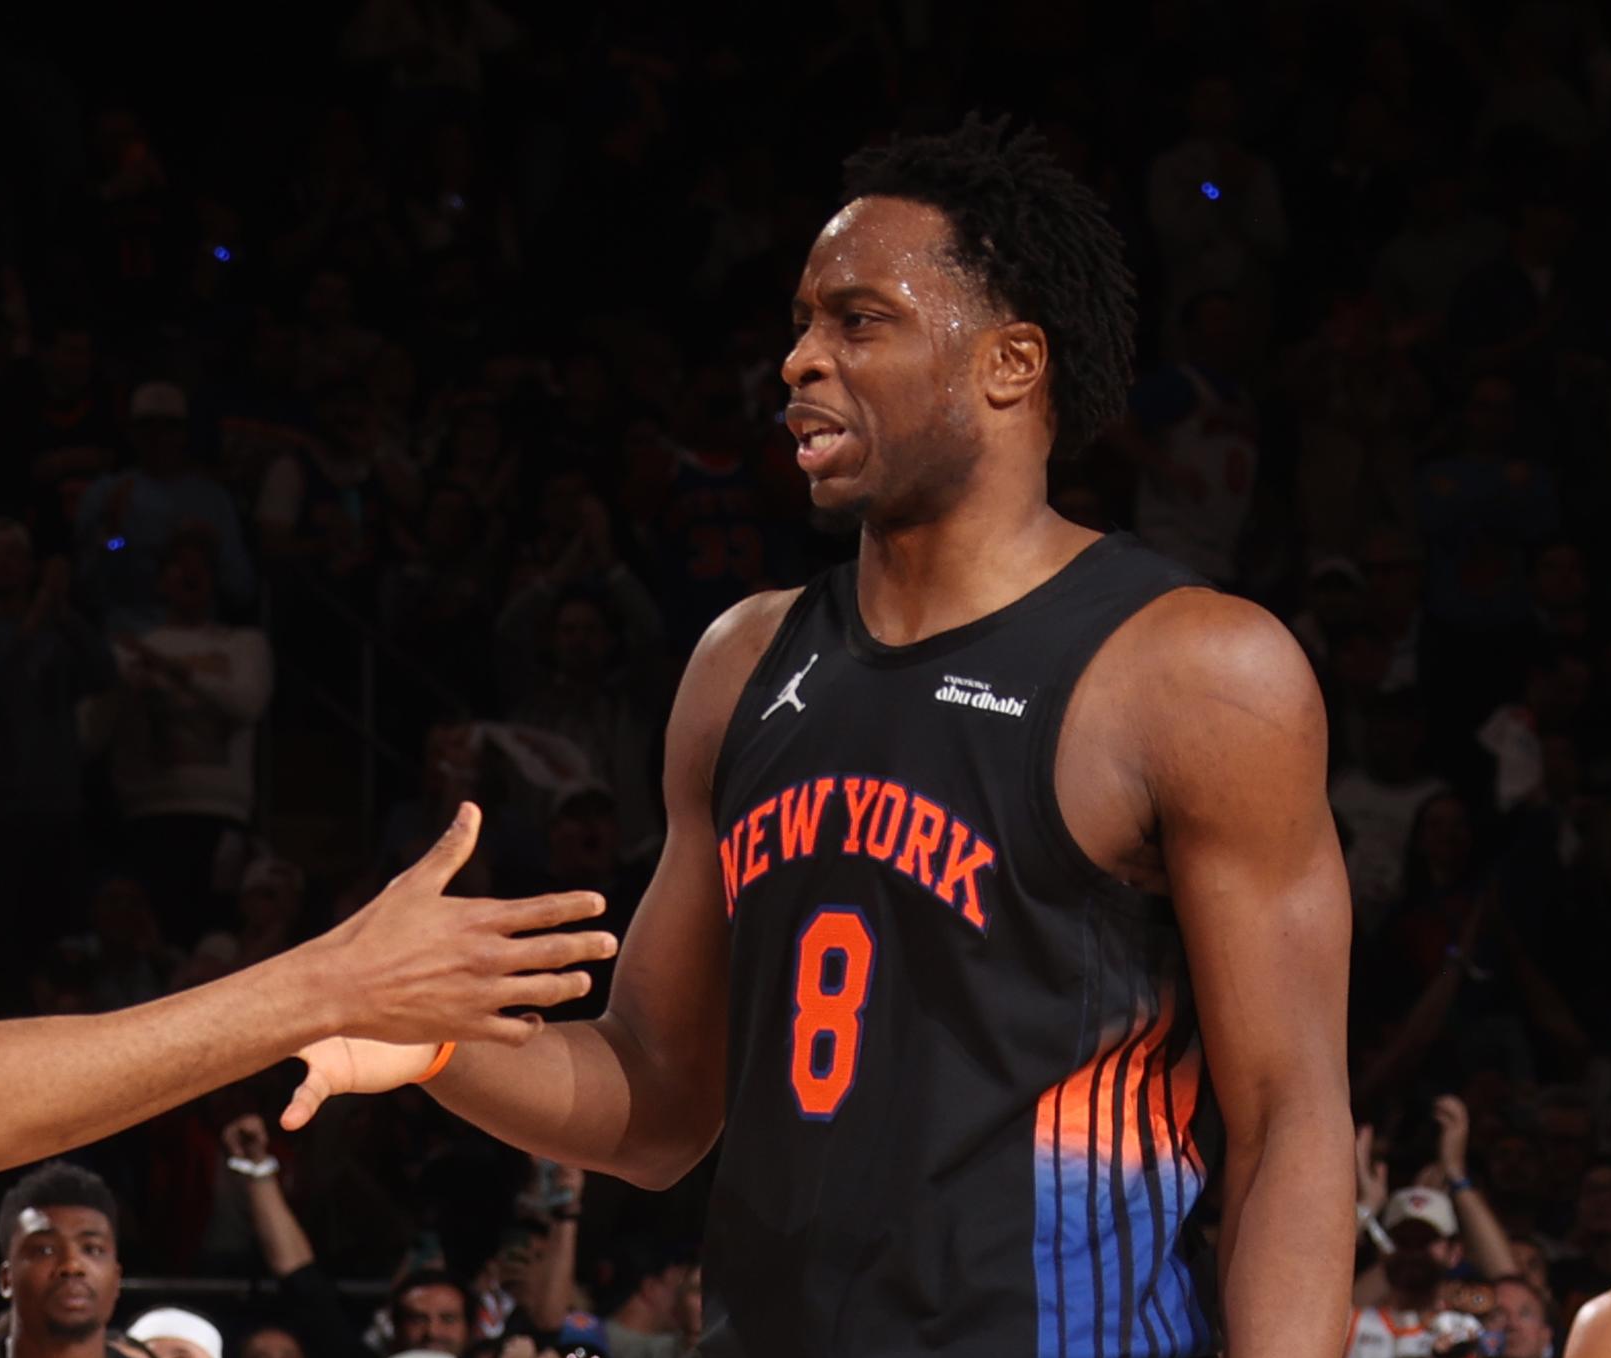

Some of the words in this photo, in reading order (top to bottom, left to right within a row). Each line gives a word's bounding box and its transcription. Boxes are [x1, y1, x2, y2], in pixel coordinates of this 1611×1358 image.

[934, 685, 972, 706] abu
[970, 691, 1028, 718] dhabi
[717, 775, 835, 924] NEW
[840, 774, 998, 938] YORK
[790, 904, 878, 1122] 8
